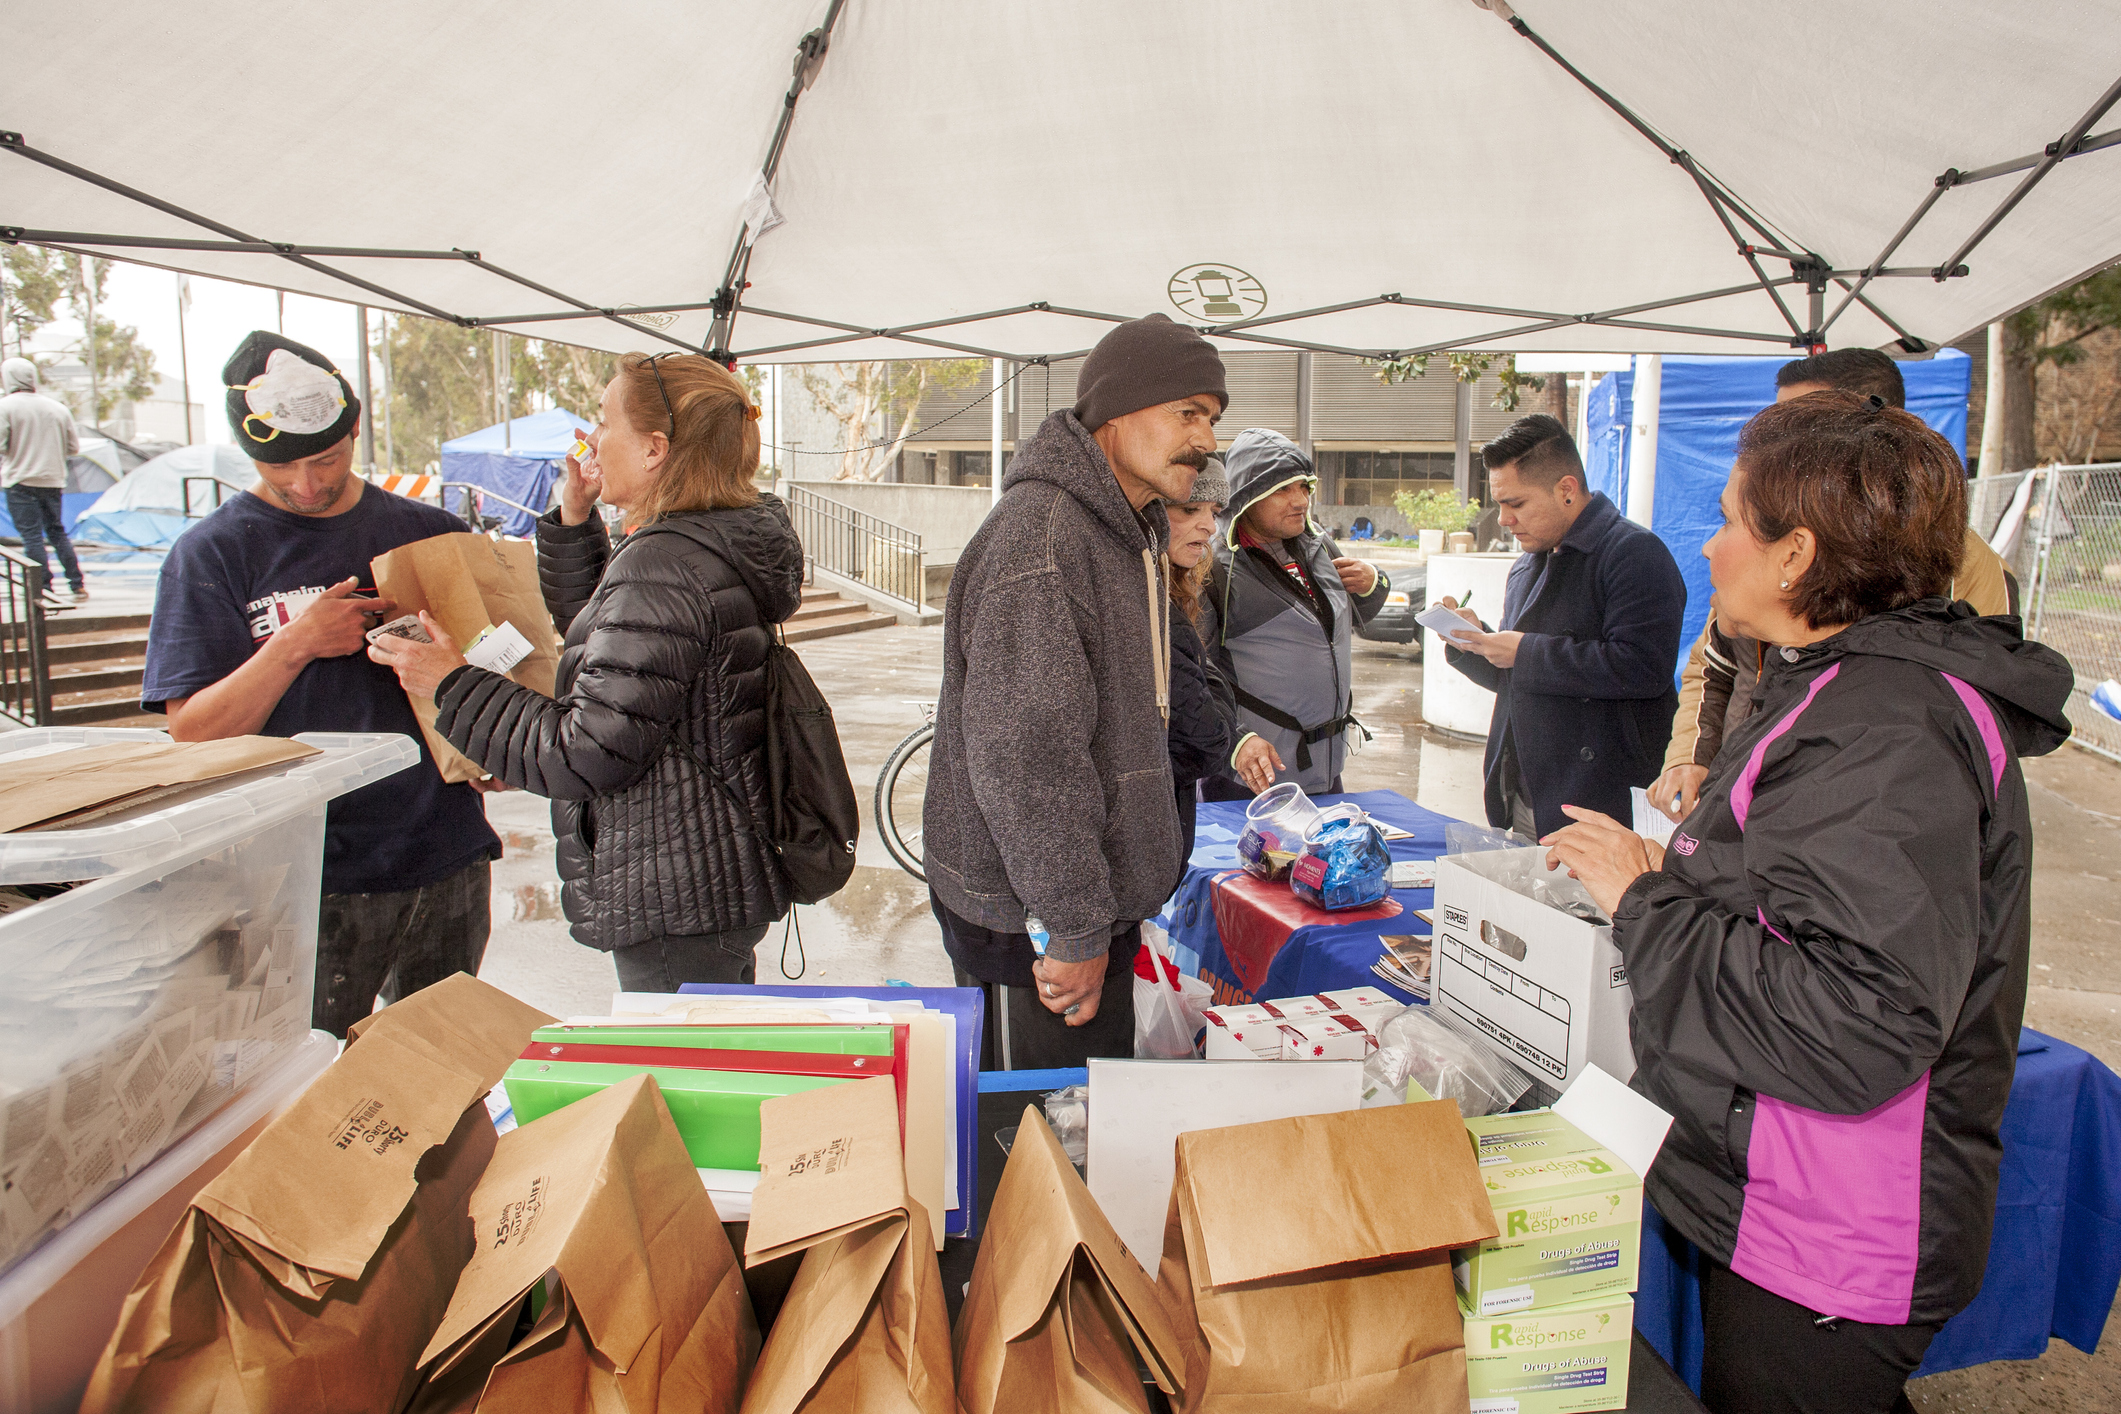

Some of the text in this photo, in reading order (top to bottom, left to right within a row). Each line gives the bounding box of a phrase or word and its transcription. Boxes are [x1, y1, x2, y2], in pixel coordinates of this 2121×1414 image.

[246, 586, 327, 613] naheim
[846, 840, 854, 854] S
[1446, 910, 1467, 925] STAPLES
[1470, 951, 1484, 961] Location
[1488, 961, 1508, 976] Destroy Date
[1490, 984, 1504, 996] Contents
[1520, 979, 1530, 988] From
[1476, 1017, 1497, 1034] 690751
[1498, 1032, 1512, 1045] 4PK
[1516, 1042, 1540, 1061] 690748
[1542, 1058, 1550, 1067] 12
[1552, 1063, 1562, 1074] PK
[336, 1126, 362, 1150] LIFE
[366, 1120, 388, 1142] DURO
[373, 1126, 409, 1156] 25 Shorty
[1494, 1144, 1508, 1152] of
[1508, 1140, 1547, 1149] Drugs
[788, 1162, 806, 1176] 25
[1503, 1156, 1613, 1178] Response
[528, 1176, 541, 1204] LIFE
[512, 1201, 522, 1236] DURO
[1506, 1208, 1598, 1238] Response
[494, 1224, 510, 1250] 25
[1540, 1238, 1620, 1260] Drugs of Abuse
[1546, 1268, 1568, 1276] individual
[1575, 1263, 1596, 1271] detección
[1484, 1300, 1494, 1308] FOR
[1496, 1297, 1522, 1306] FORENSIC
[1490, 1324, 1586, 1349] Response
[1522, 1355, 1608, 1372] Drugs of Abuse
